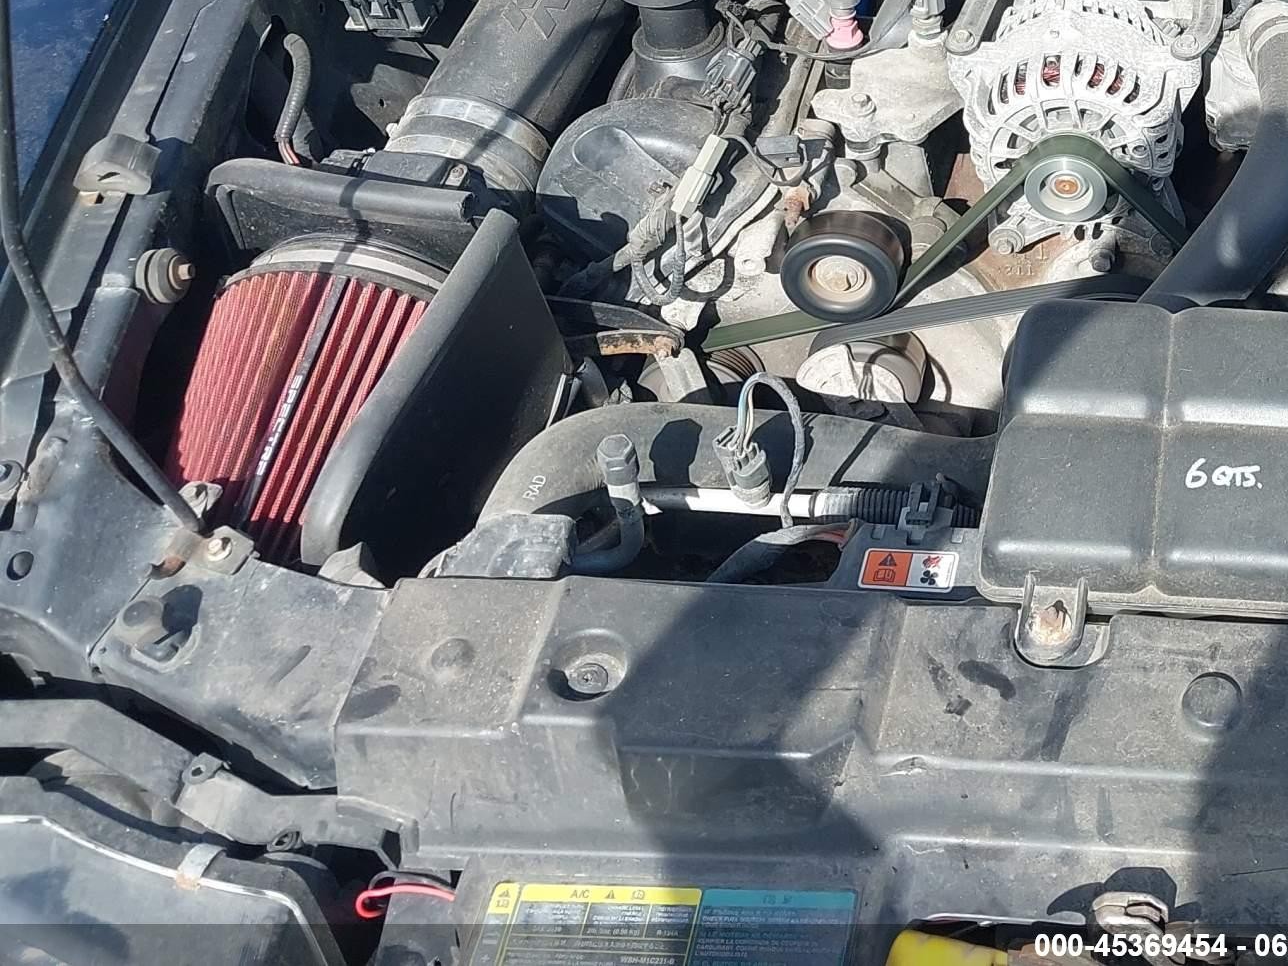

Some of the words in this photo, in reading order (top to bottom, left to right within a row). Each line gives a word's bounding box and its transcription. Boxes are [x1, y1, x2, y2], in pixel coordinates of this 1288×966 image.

[256, 375, 303, 476] SPECTRE
[1185, 457, 1208, 489] 6
[522, 475, 546, 501] RAD
[570, 889, 590, 899] A/C
